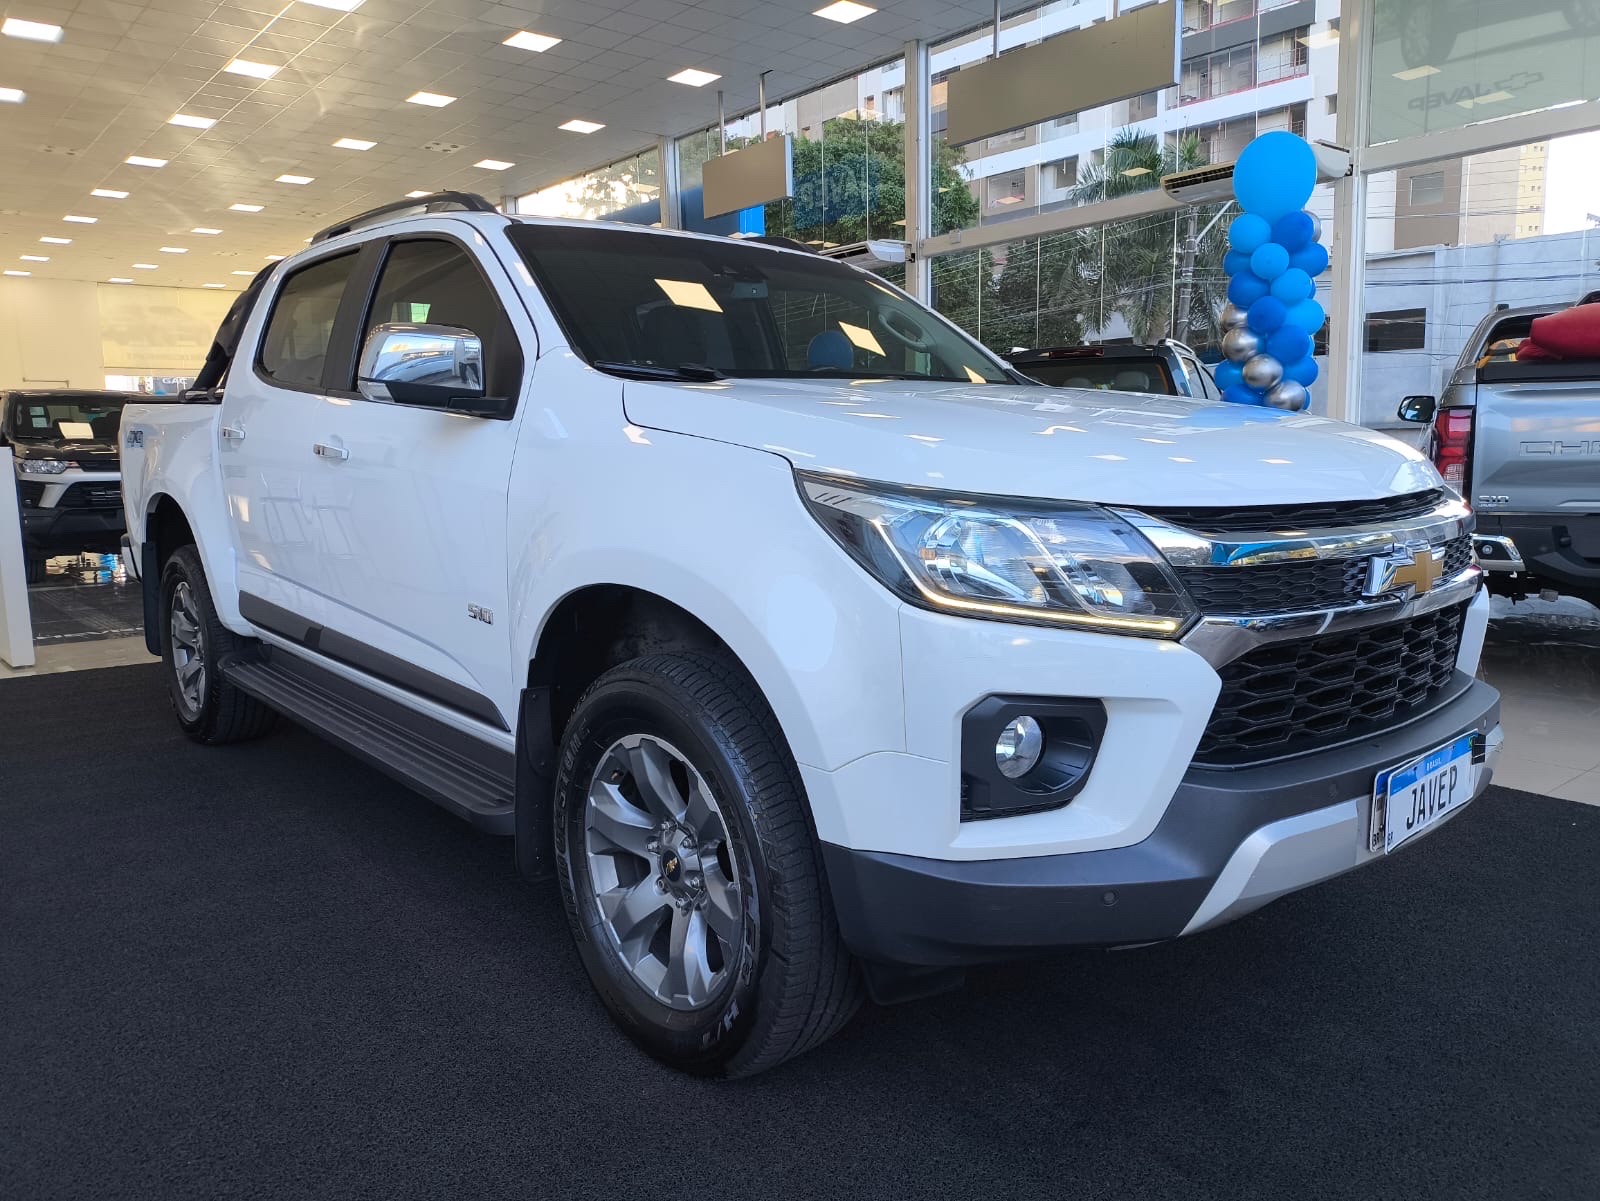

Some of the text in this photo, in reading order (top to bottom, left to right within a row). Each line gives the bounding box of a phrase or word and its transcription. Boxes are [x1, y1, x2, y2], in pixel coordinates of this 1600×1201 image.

[1479, 495, 1509, 503] S10
[467, 603, 494, 625] S10
[1406, 764, 1458, 830] JAVEP
